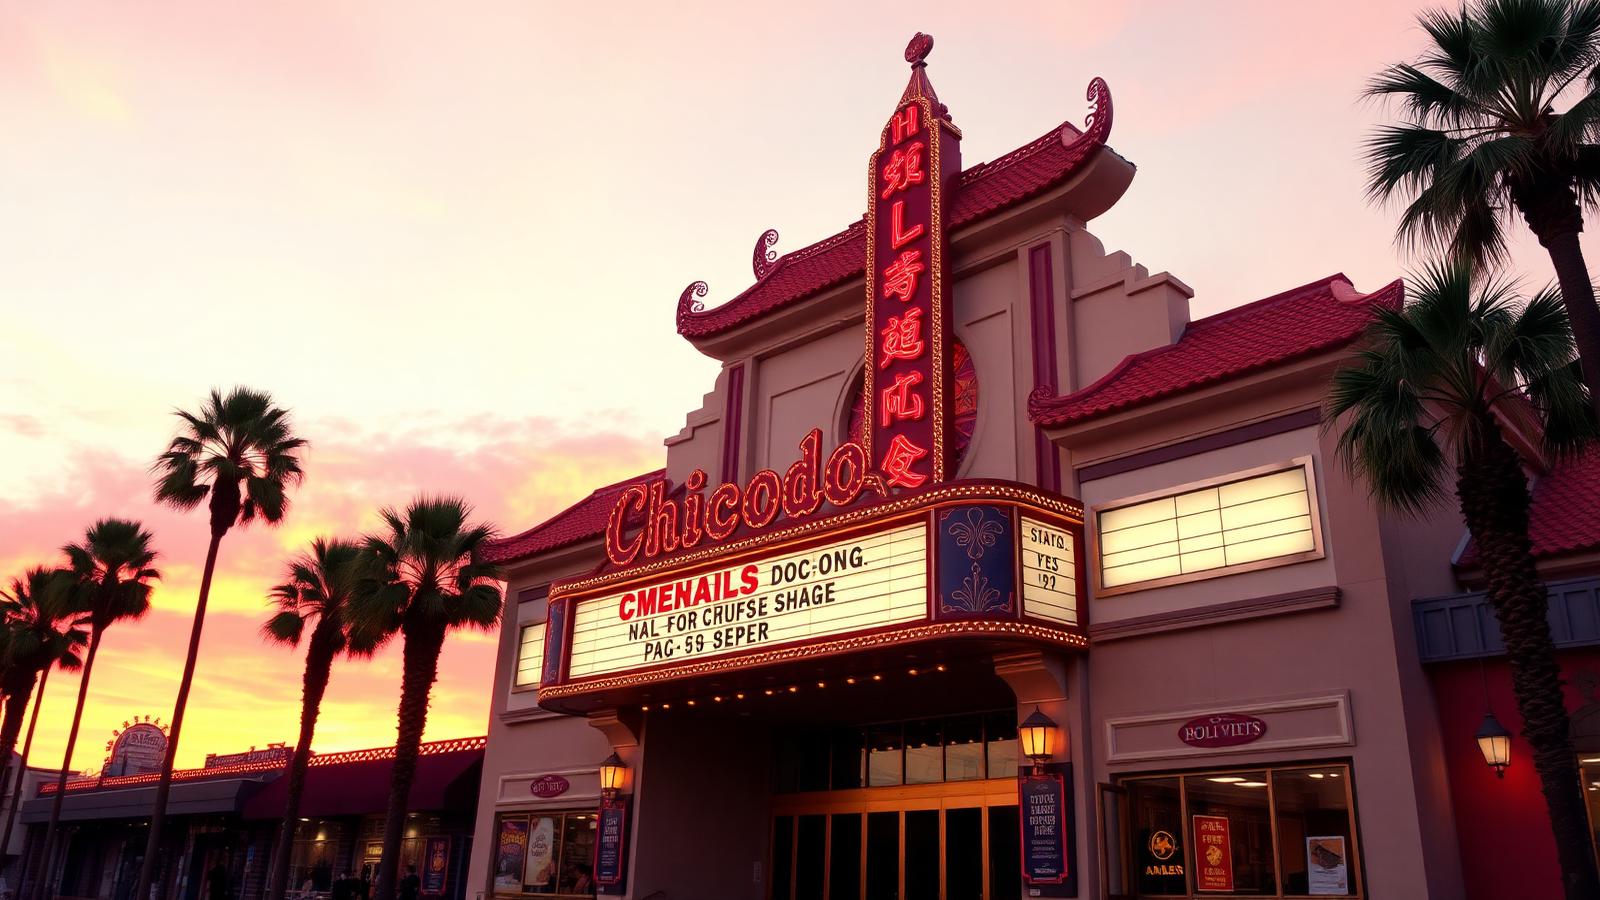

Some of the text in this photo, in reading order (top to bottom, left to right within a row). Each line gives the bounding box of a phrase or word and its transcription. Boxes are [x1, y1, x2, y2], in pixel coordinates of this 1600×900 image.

[618, 564, 759, 621] CMENAILS
[629, 582, 836, 641] NAL FOR CRUFSE SHAGE
[713, 622, 769, 649] SEPER
